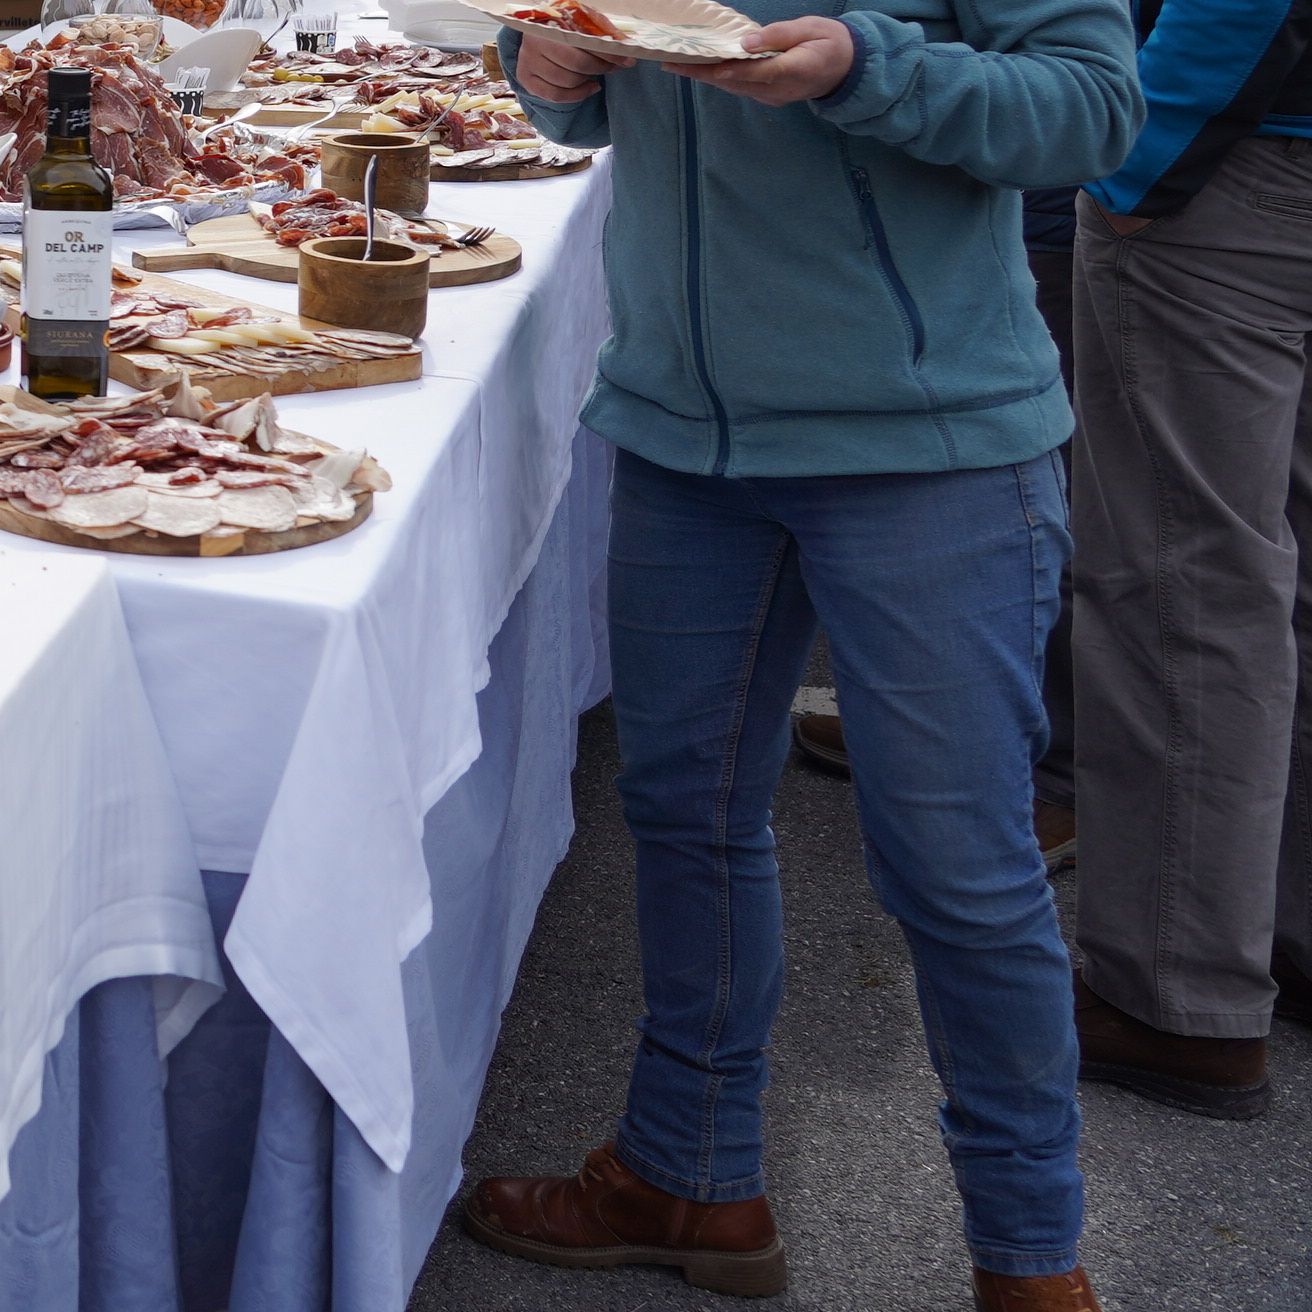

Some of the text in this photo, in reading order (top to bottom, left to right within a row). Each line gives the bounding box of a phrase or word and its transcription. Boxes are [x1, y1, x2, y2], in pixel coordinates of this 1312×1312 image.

[65, 231, 84, 243] OR
[45, 243, 104, 253] DEL CAMP
